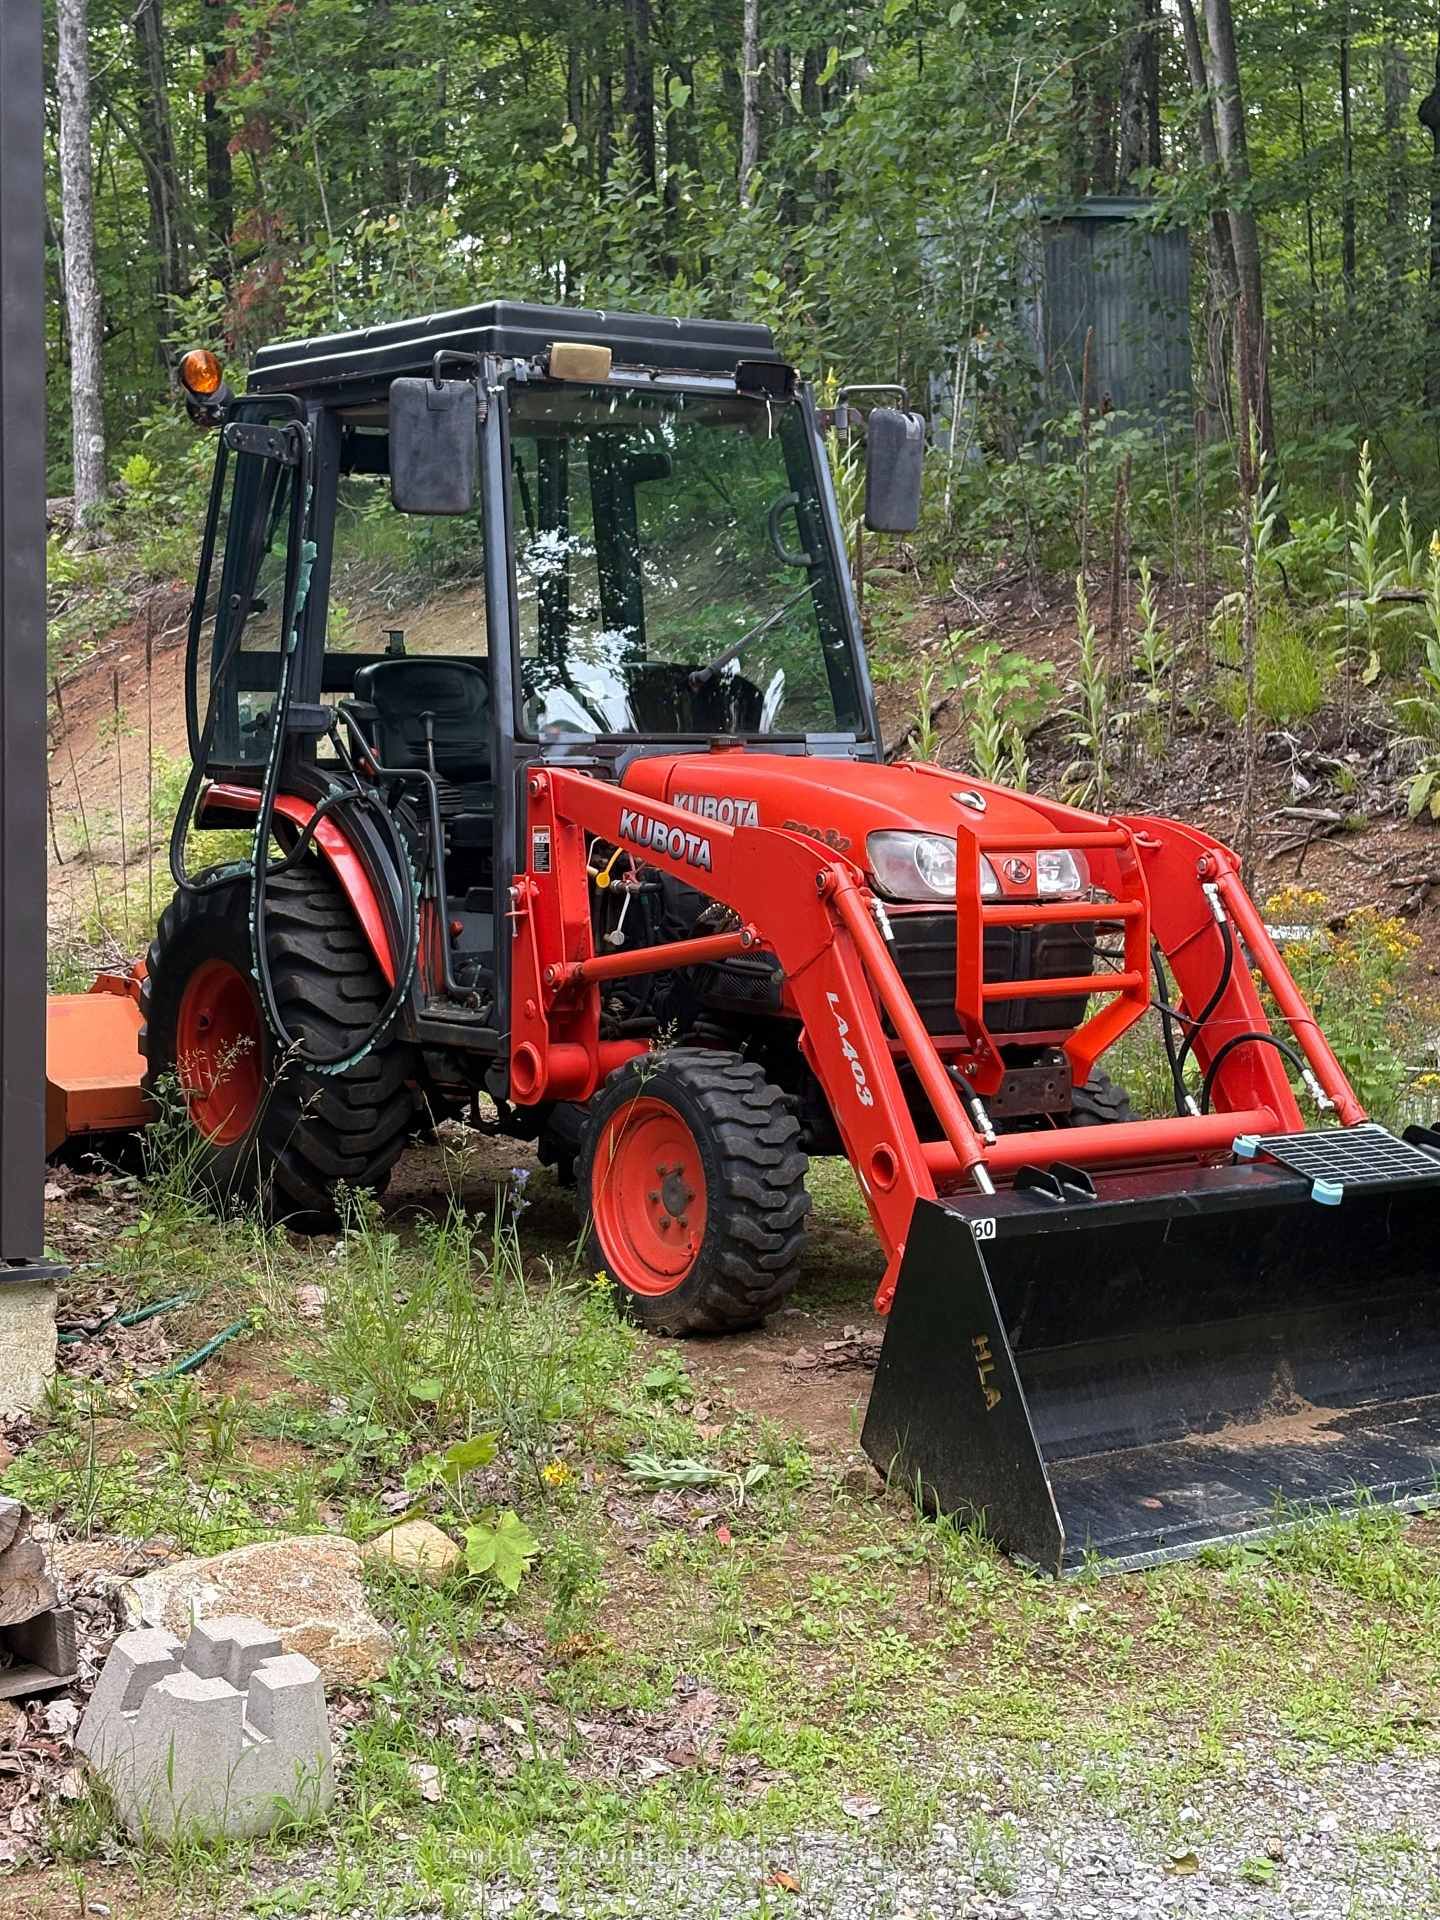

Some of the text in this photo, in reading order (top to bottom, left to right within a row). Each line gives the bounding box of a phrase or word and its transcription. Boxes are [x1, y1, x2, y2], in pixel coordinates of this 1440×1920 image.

[618, 808, 713, 873] KUBOTA
[673, 793, 760, 827] KUBOTA
[825, 991, 875, 1107] LA403
[974, 1219, 994, 1238] 60
[971, 1335, 1002, 1412] HLA
